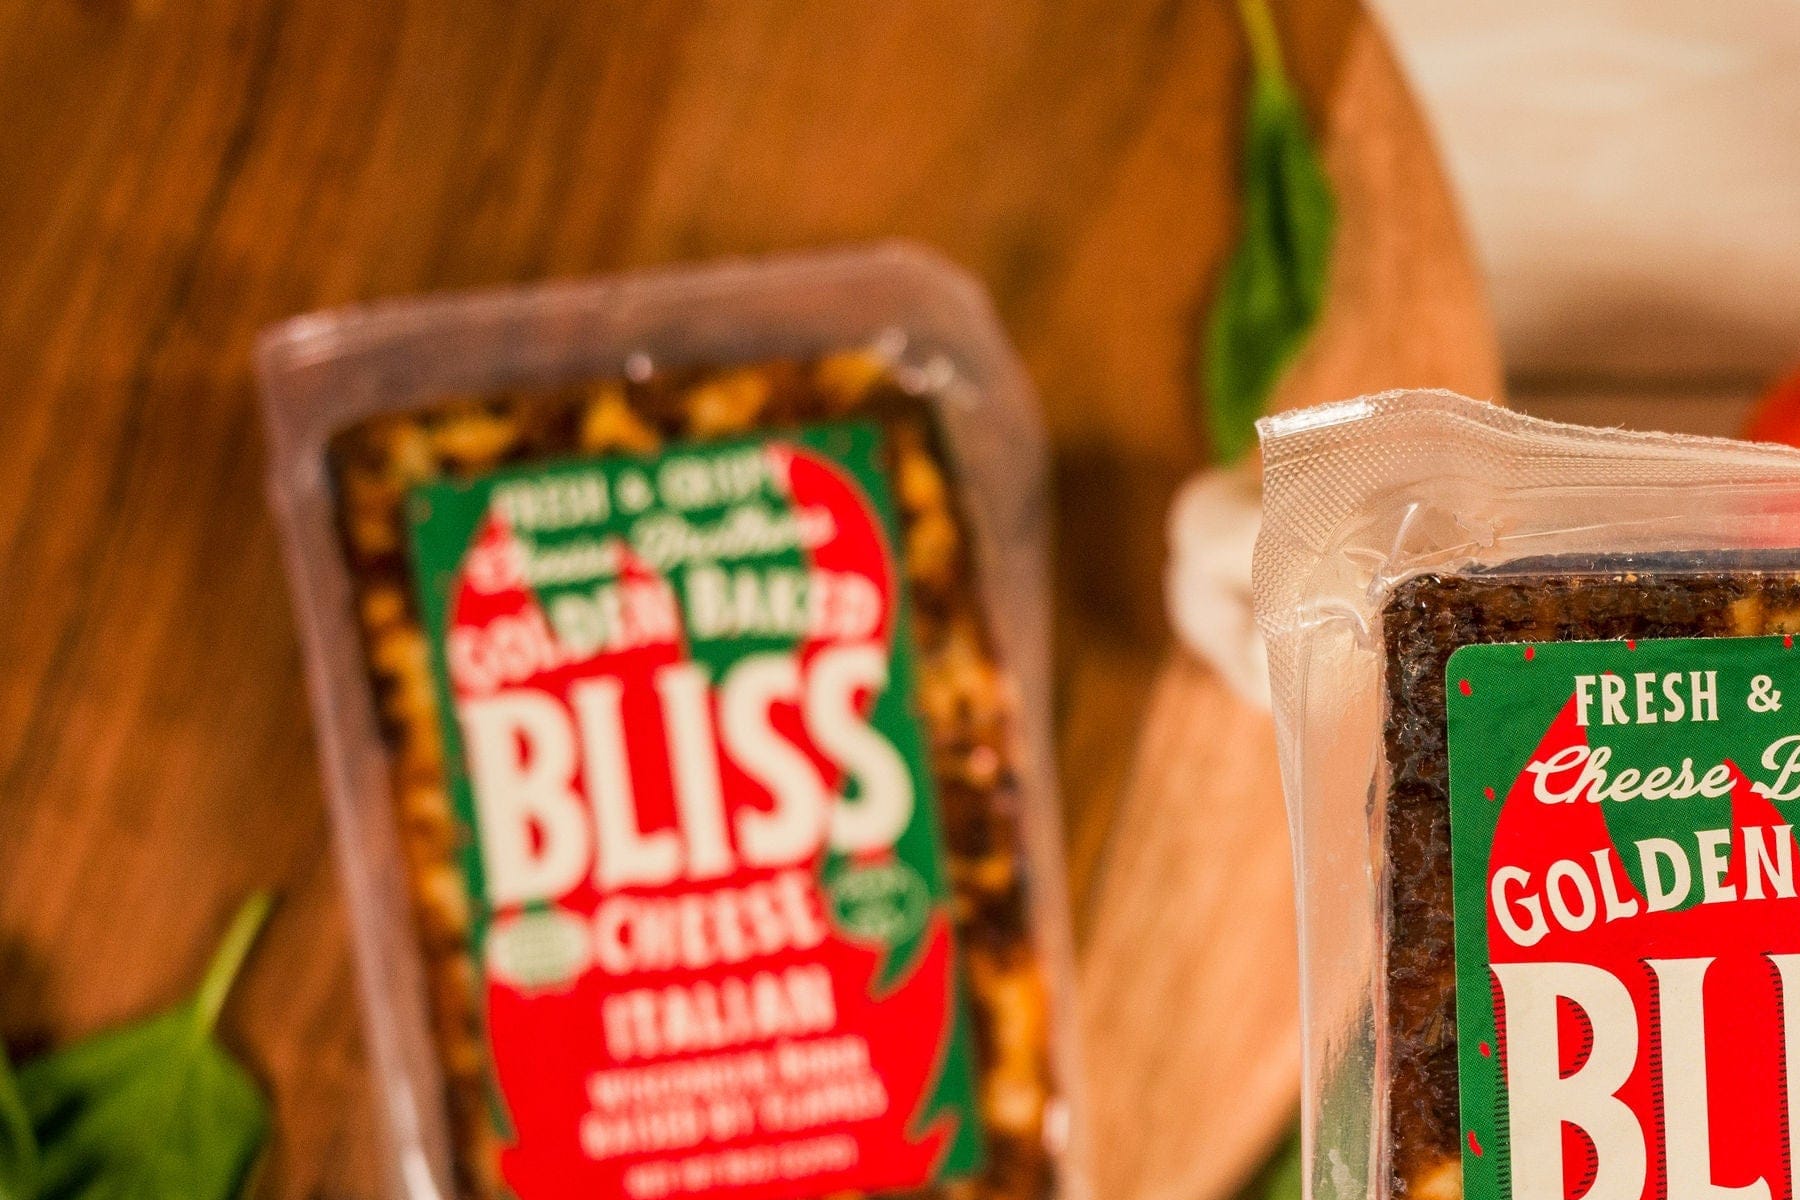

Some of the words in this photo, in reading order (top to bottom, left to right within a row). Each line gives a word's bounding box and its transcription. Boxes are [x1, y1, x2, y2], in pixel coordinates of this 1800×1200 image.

[1574, 670, 1720, 726] FRESH
[1747, 674, 1783, 712] &
[458, 642, 915, 907] BLISS
[1525, 744, 1737, 805] Cheese
[594, 868, 826, 975] CHEESE
[1490, 824, 1798, 947] GOLDEN
